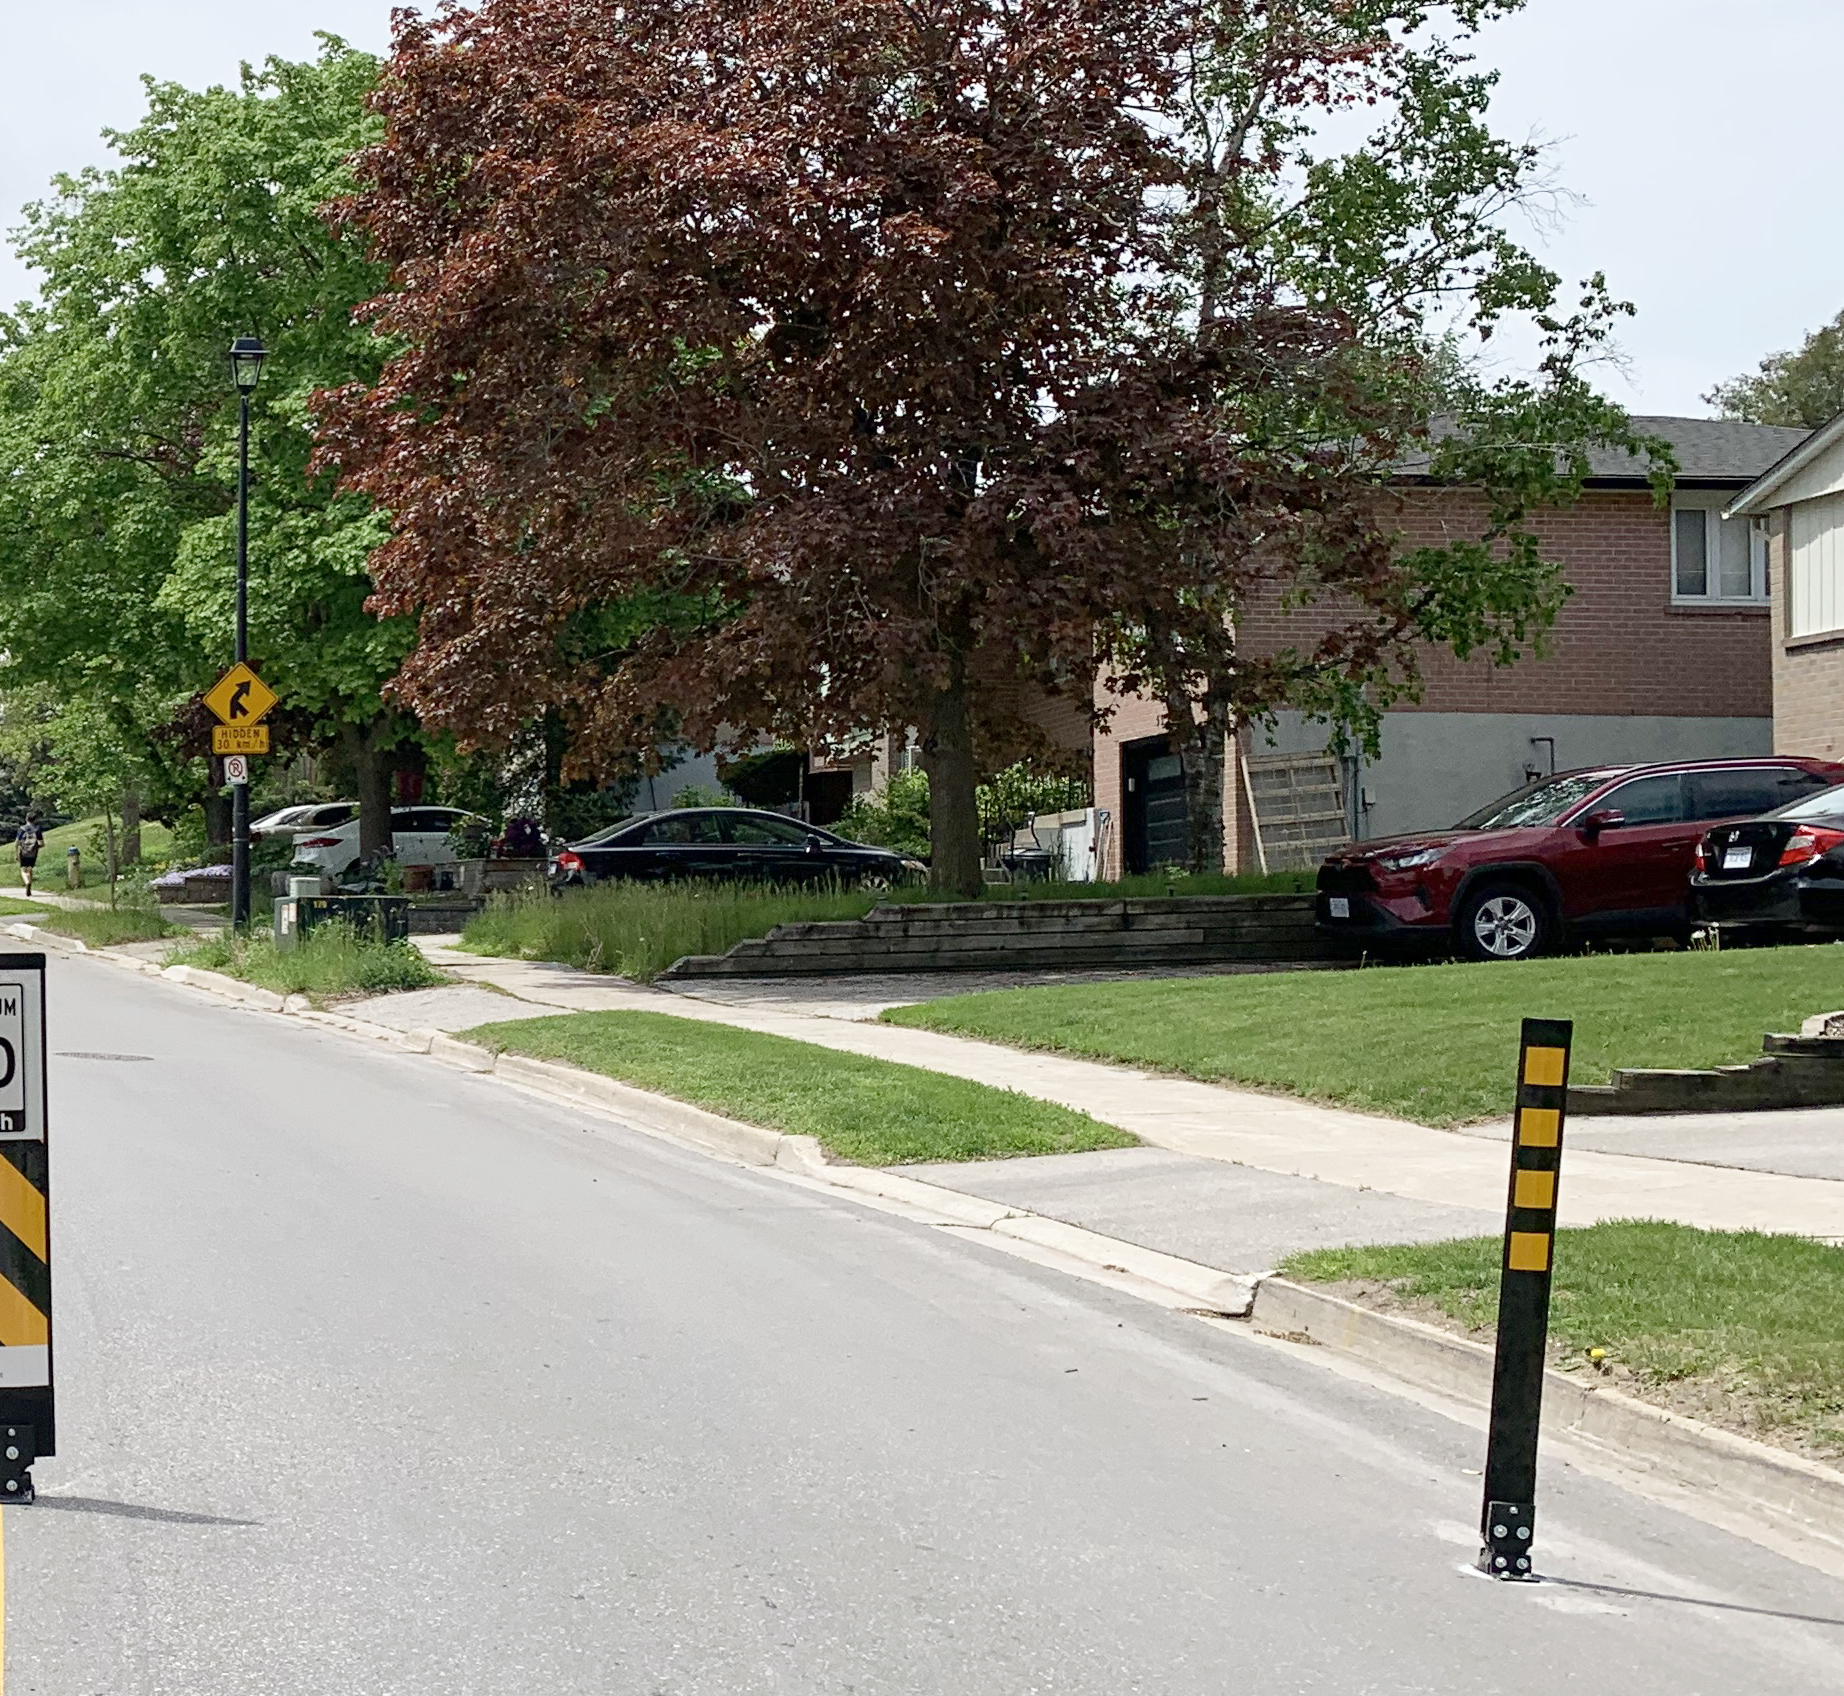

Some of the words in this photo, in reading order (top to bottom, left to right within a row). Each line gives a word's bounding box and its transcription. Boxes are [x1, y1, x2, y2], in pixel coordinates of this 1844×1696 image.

[221, 729, 260, 738] HIDDEN
[217, 739, 230, 750] 30
[236, 739, 266, 750] km/h
